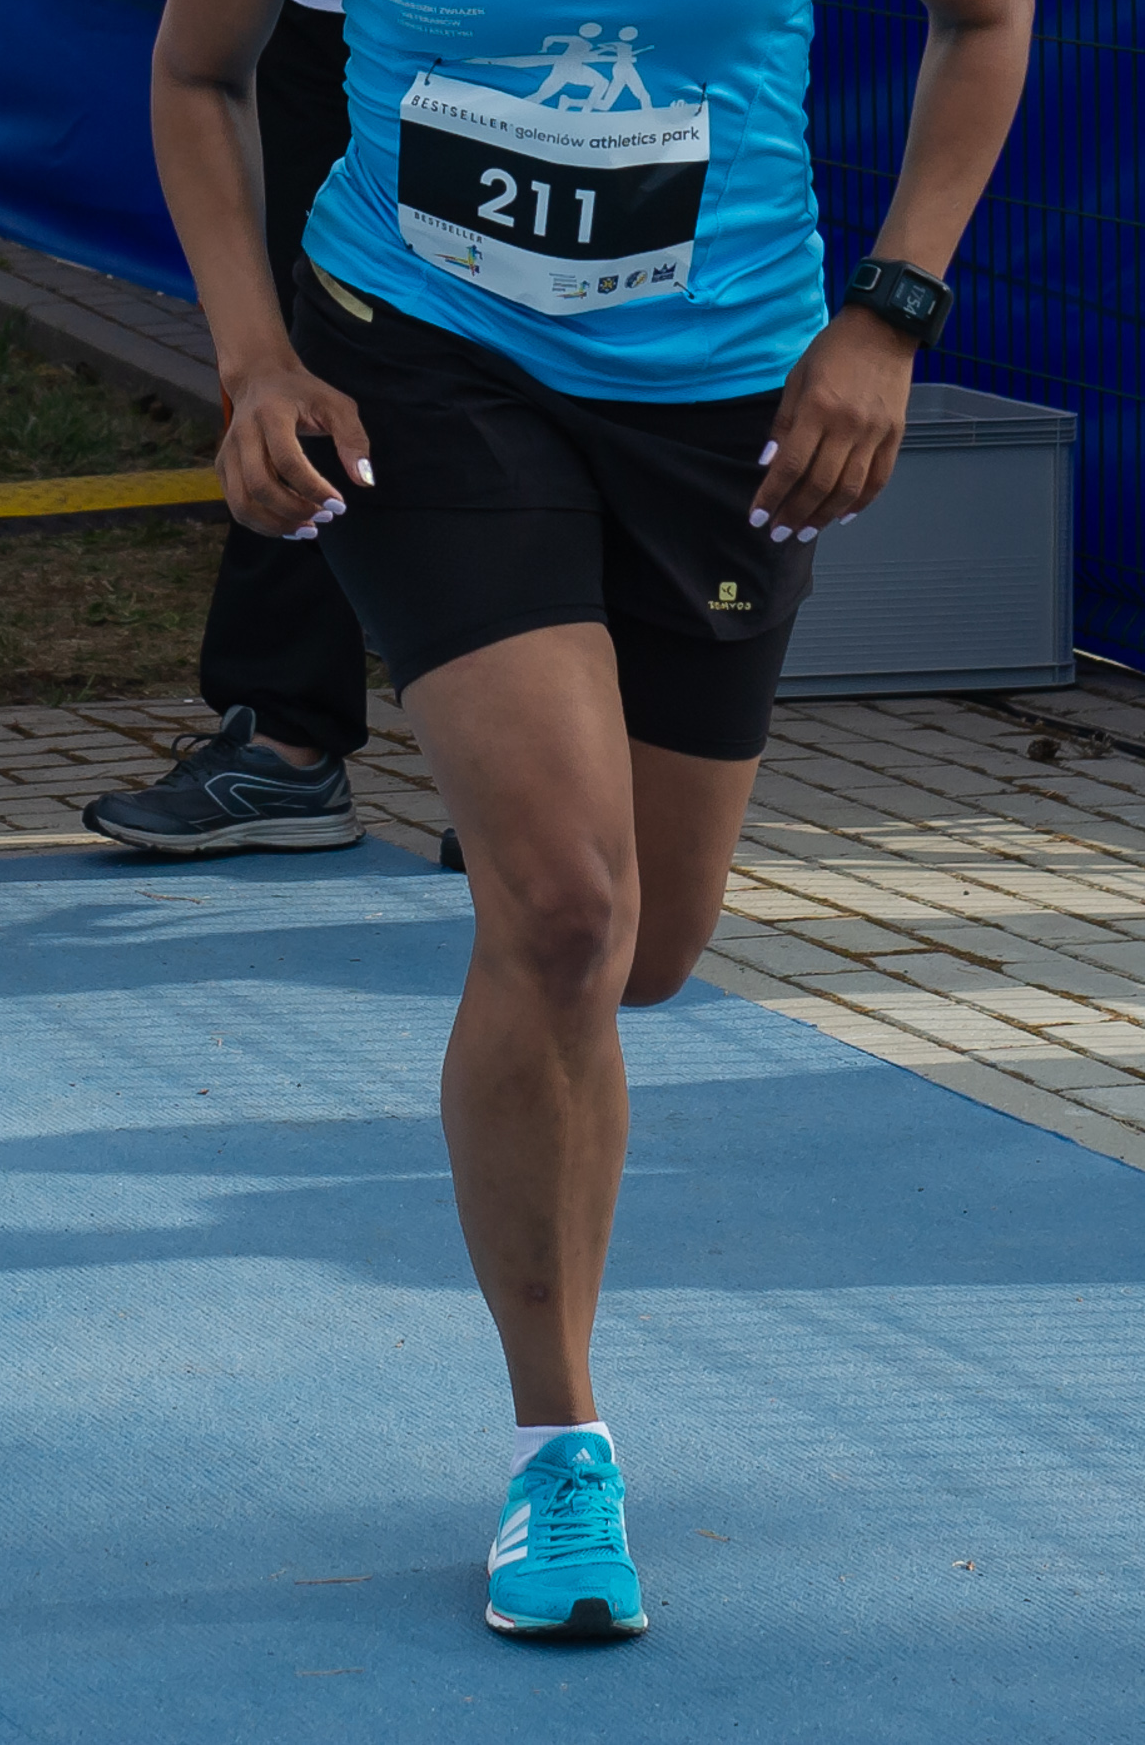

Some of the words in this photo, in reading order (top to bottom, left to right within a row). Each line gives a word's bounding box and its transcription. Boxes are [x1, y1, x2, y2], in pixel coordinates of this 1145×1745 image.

[410, 95, 509, 131] BESTSELLER
[515, 124, 585, 148] goleniów
[589, 131, 657, 149] athletics
[661, 126, 700, 146] park
[414, 211, 483, 244] BESTSELLER
[477, 168, 596, 244] 211
